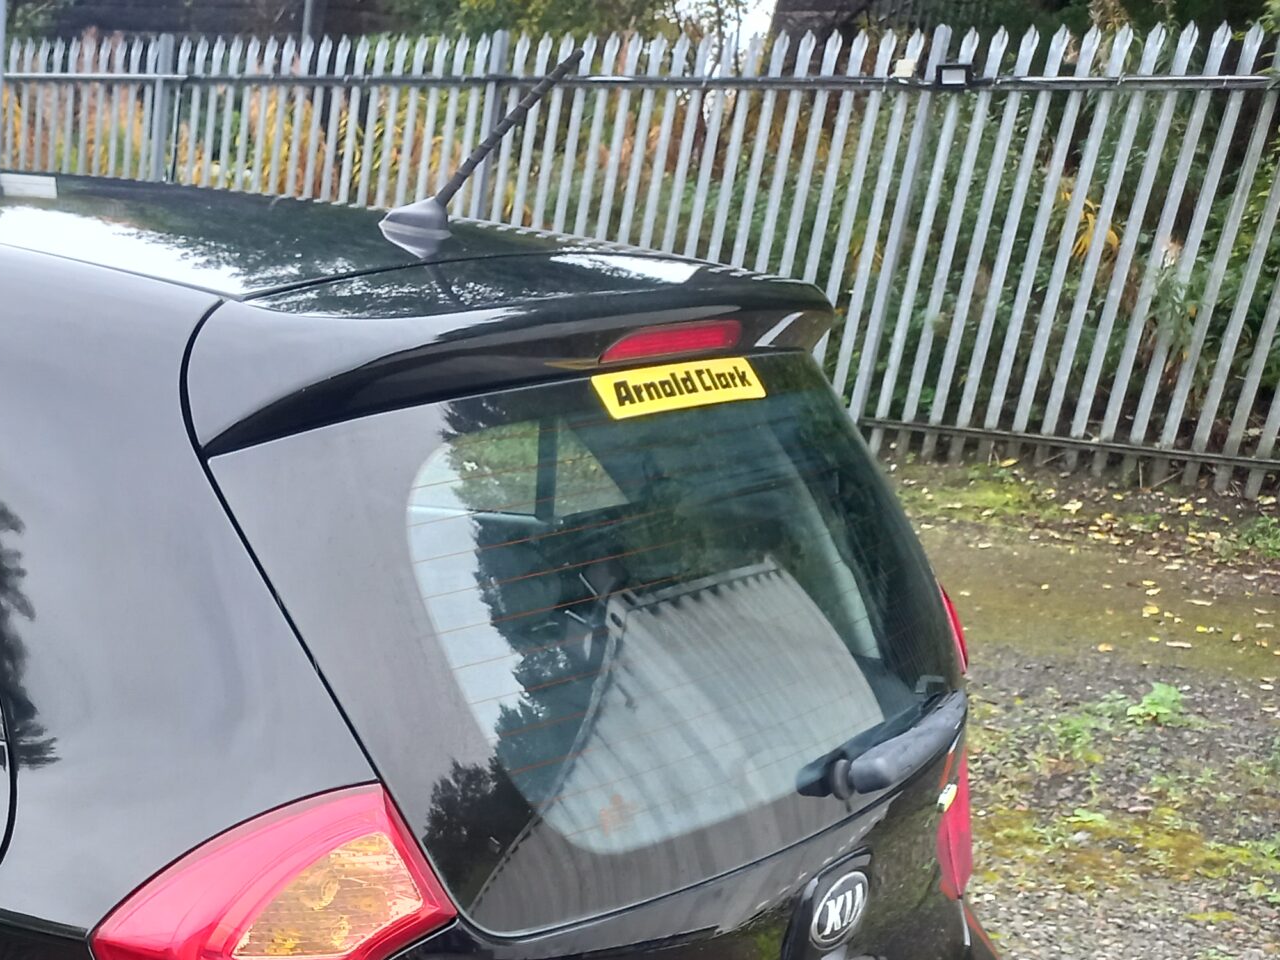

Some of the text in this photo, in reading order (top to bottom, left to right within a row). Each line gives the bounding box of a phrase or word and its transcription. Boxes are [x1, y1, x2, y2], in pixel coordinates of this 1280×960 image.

[613, 366, 752, 407] Arnold Clark
[821, 881, 864, 936] KIA
